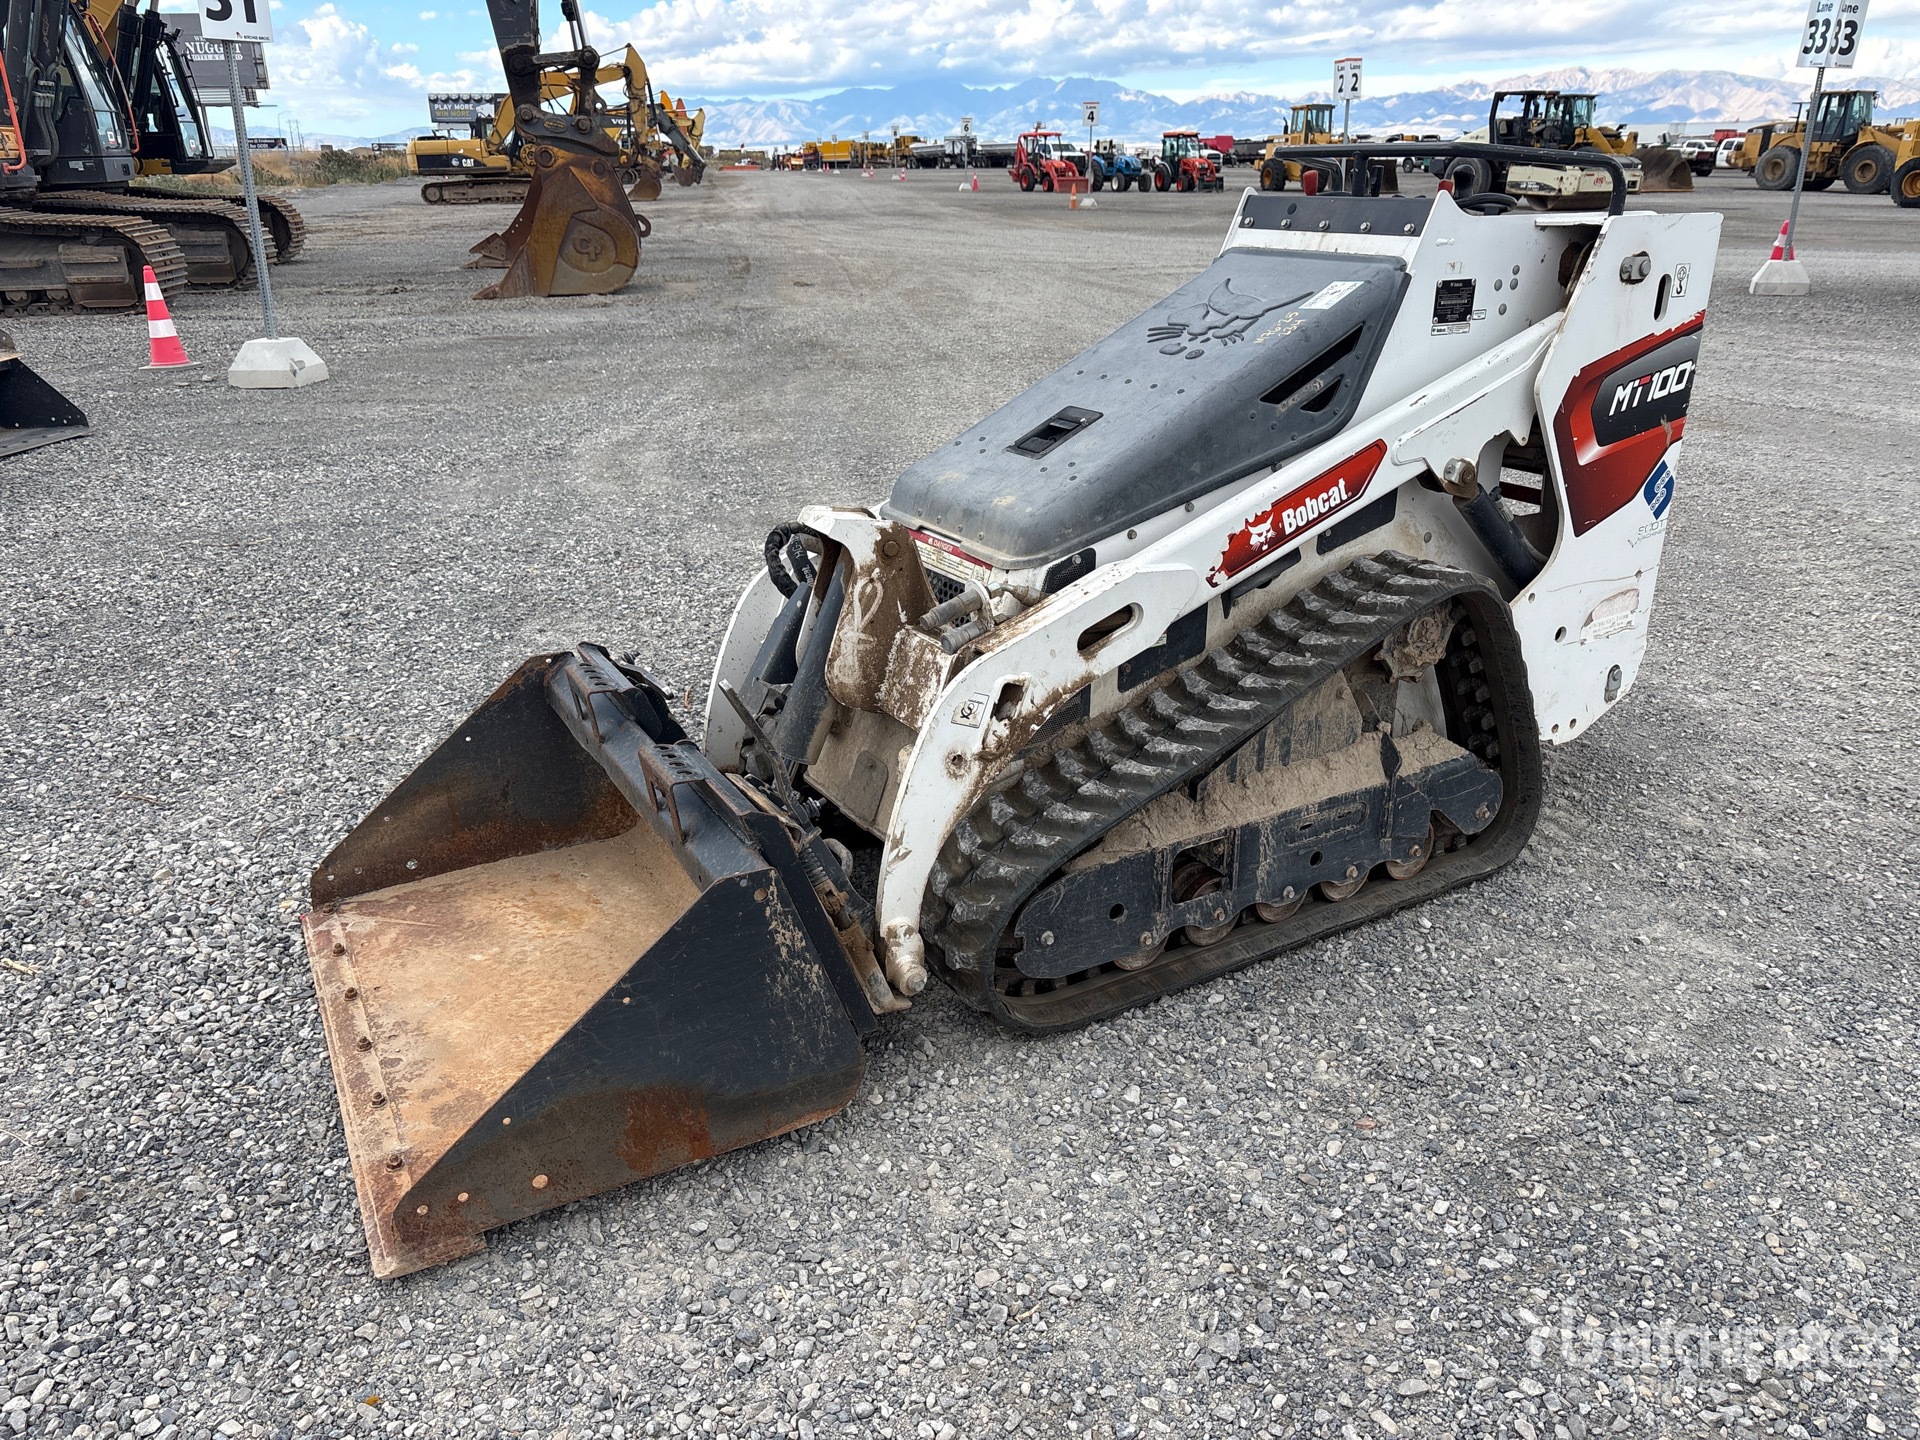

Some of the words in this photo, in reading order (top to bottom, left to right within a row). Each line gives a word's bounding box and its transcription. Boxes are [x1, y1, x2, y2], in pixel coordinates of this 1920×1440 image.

[1816, 2, 1833, 13] Lane
[1802, 18, 1831, 54] 33
[185, 41, 241, 54] NUGGT
[1350, 72, 1358, 92] 2
[1087, 111, 1095, 122] 4
[963, 124, 969, 132] 6
[462, 159, 475, 167] CAT
[1608, 360, 1693, 417] MT100
[1281, 477, 1348, 536] Bobcat
[933, 539, 954, 553] DANGER
